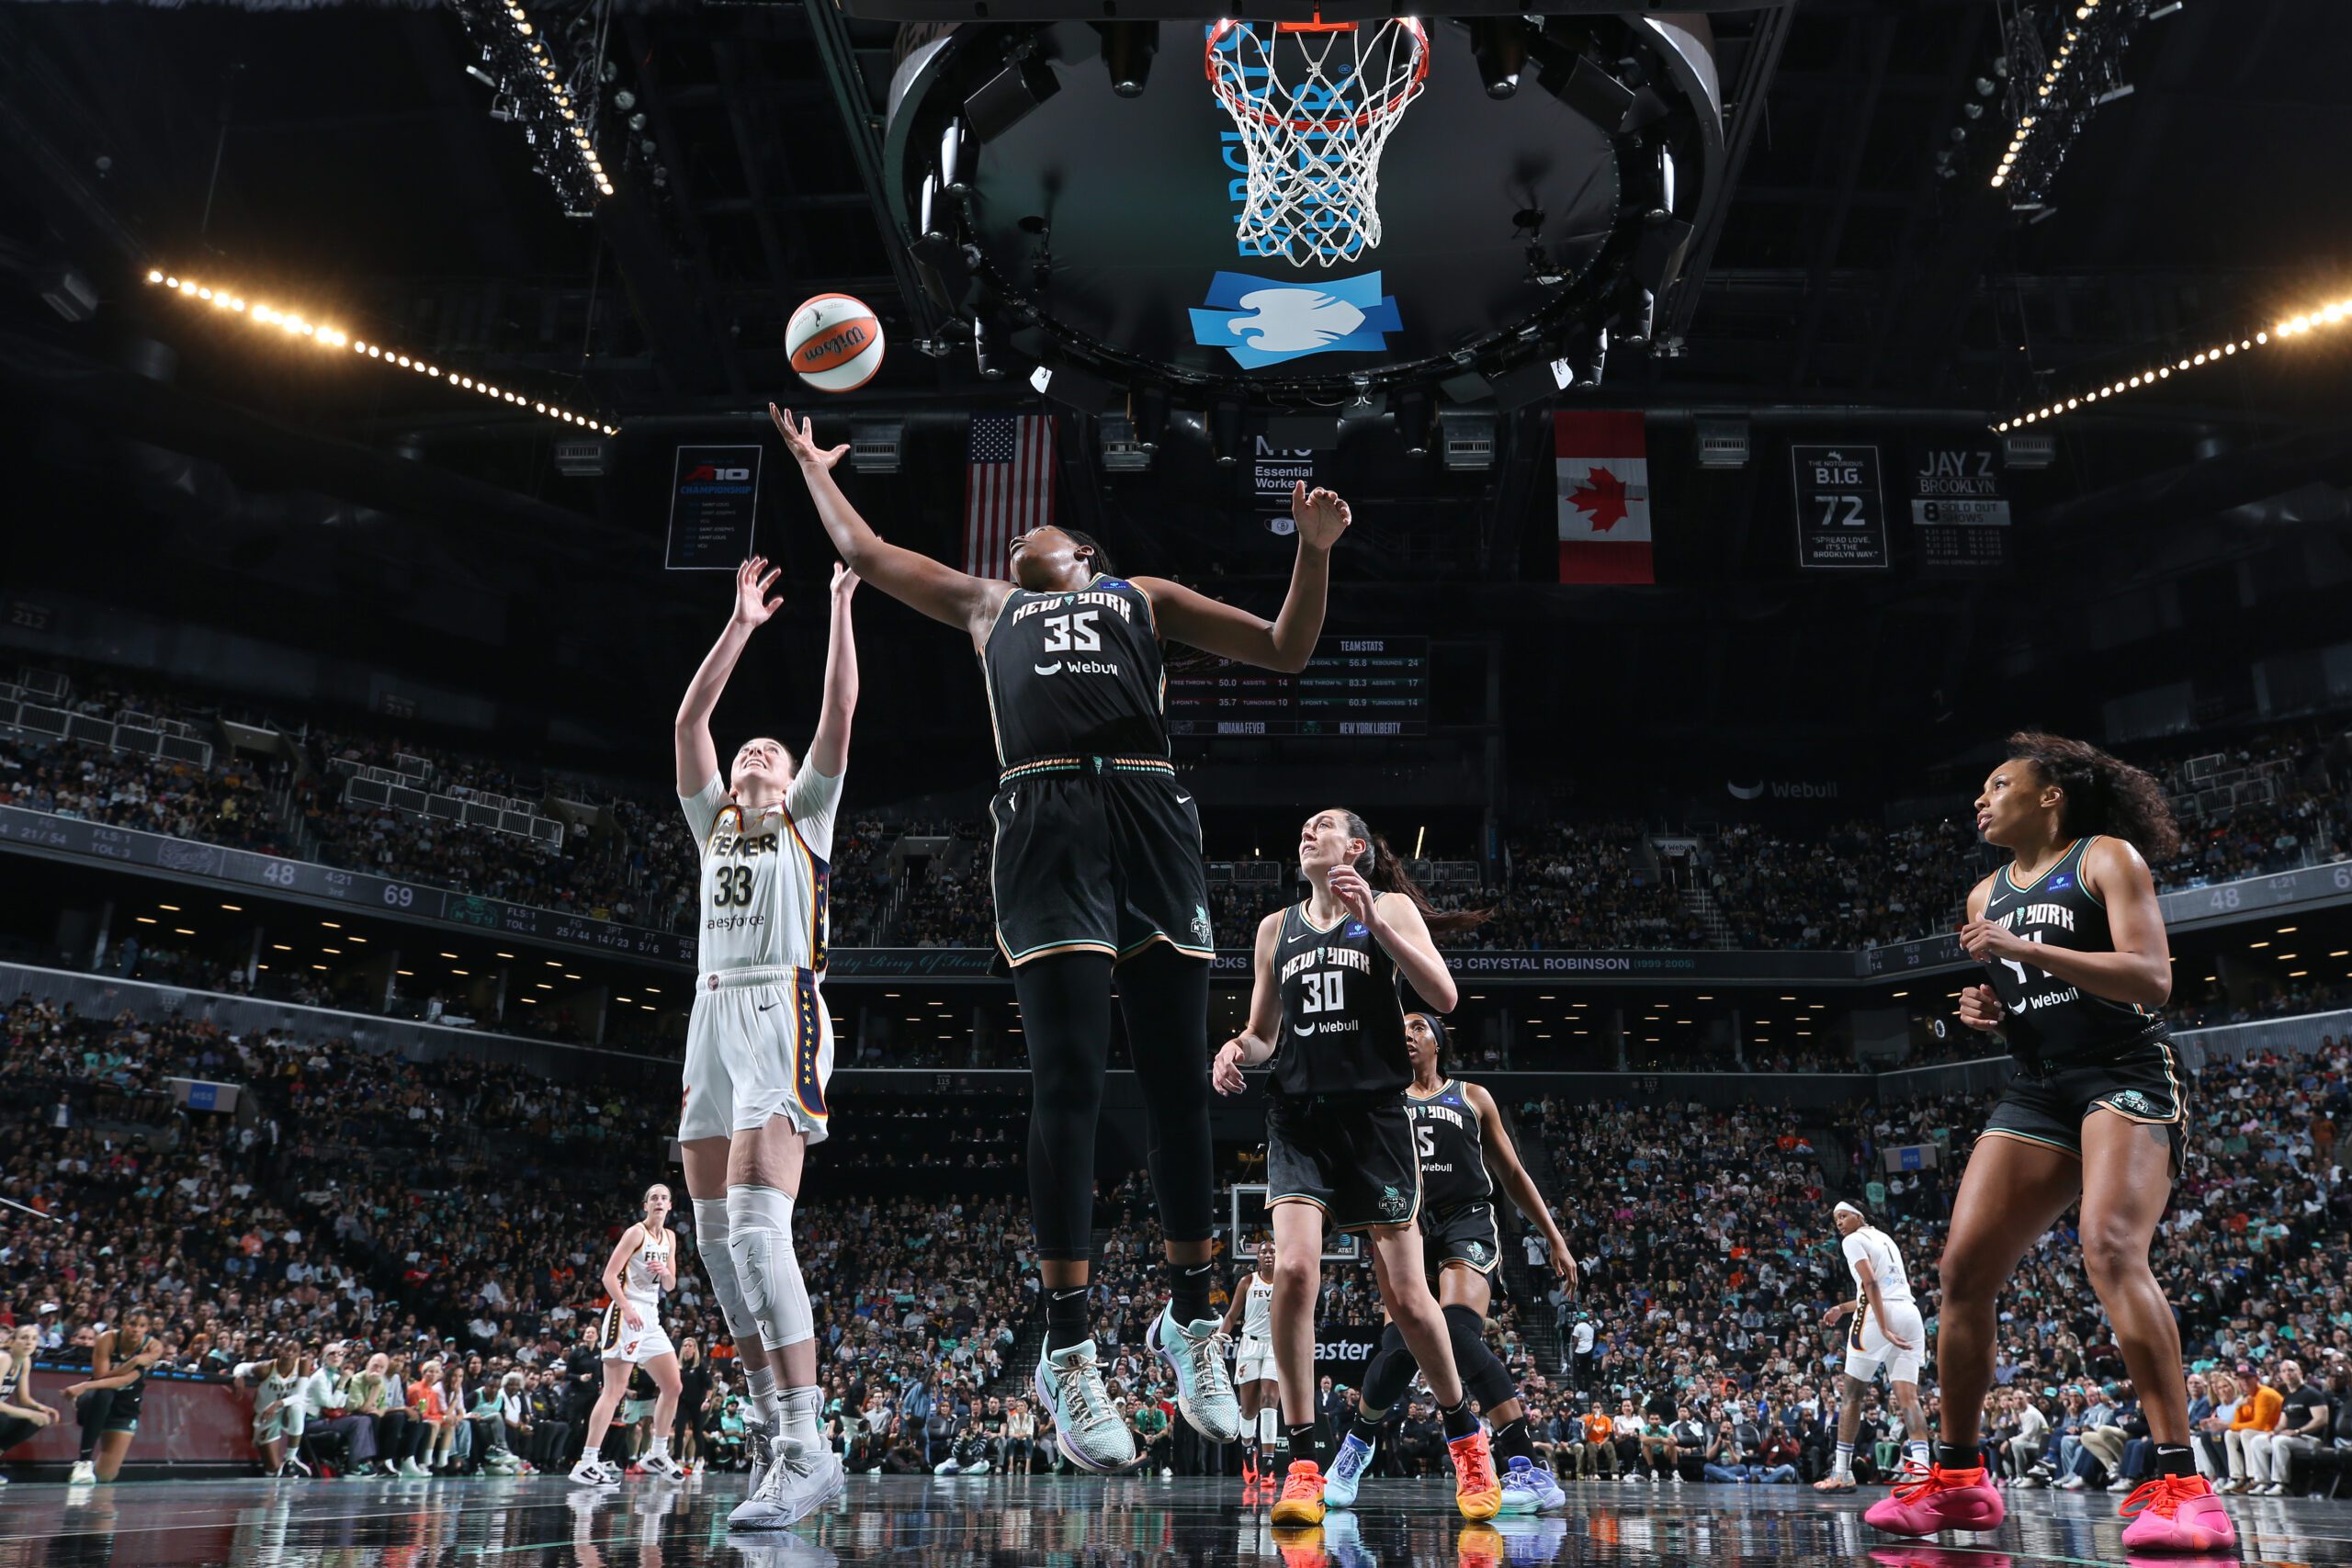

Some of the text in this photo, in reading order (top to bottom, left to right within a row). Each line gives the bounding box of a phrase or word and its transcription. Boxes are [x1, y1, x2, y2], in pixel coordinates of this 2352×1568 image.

[804, 326, 865, 360] Wilson
[1918, 451, 1994, 477] JAY Z
[1255, 466, 1313, 477] Essential
[1815, 468, 1862, 484] B.I.G.
[681, 485, 752, 494] CHAMPIONSHIP
[1255, 478, 1308, 488] Workes
[1920, 479, 1996, 493] BROOKLYN
[1815, 496, 1866, 525] 72
[1924, 502, 1939, 522] 8
[1940, 503, 1997, 512] SOLD OUT
[1942, 514, 1984, 523] SHOWS
[1012, 592, 1132, 626] NEW YORK
[1044, 610, 1101, 652] 35
[1340, 641, 1384, 651] TEAM STATS
[1067, 660, 1118, 676] Webull
[1348, 659, 1367, 667] 56.8
[1408, 659, 1419, 667] 24
[1278, 679, 1288, 687] 14
[1408, 679, 1418, 687] 17
[1217, 722, 1265, 734] INDIANA FEVER
[1340, 722, 1401, 734] NEW YORK LIBERTY
[1770, 781, 1838, 798] Webull
[324, 873, 353, 886] 4:21
[2267, 875, 2296, 889] 4:21
[2334, 867, 2352, 889] 6
[264, 863, 413, 908] 48 69
[714, 866, 752, 907] 33
[2210, 887, 2240, 909] 48
[570, 919, 582, 928] FG
[2025, 903, 2075, 933] YORK
[556, 927, 569, 938] 25
[577, 931, 590, 941] 44
[606, 926, 623, 935] 3PT
[645, 932, 656, 942] FT
[597, 934, 609, 944] 14
[616, 938, 629, 948] 23
[639, 942, 645, 952] 5
[652, 944, 660, 953] 6
[679, 939, 695, 949] REB
[1943, 938, 1954, 947] FT
[680, 950, 691, 959] 24
[1904, 944, 1920, 954] REB
[1952, 947, 1960, 957] 2
[869, 955, 914, 974] Ring
[1209, 957, 1248, 968] ICKS
[1281, 946, 1372, 985] NEW YORK
[1467, 957, 1541, 970] CRYSTAL
[1543, 957, 1630, 970] ROBINSON
[1634, 958, 1695, 969] (1999-2005)
[1871, 962, 1883, 970] 14
[1907, 955, 1919, 964] 23
[1301, 970, 1345, 1014] 30
[2030, 986, 2080, 1010] Webull
[1318, 1020, 1359, 1033] Webull
[1427, 1105, 1464, 1130] YORK
[645, 1251, 669, 1262] FEVE
[1253, 1290, 1272, 1298] FEV
